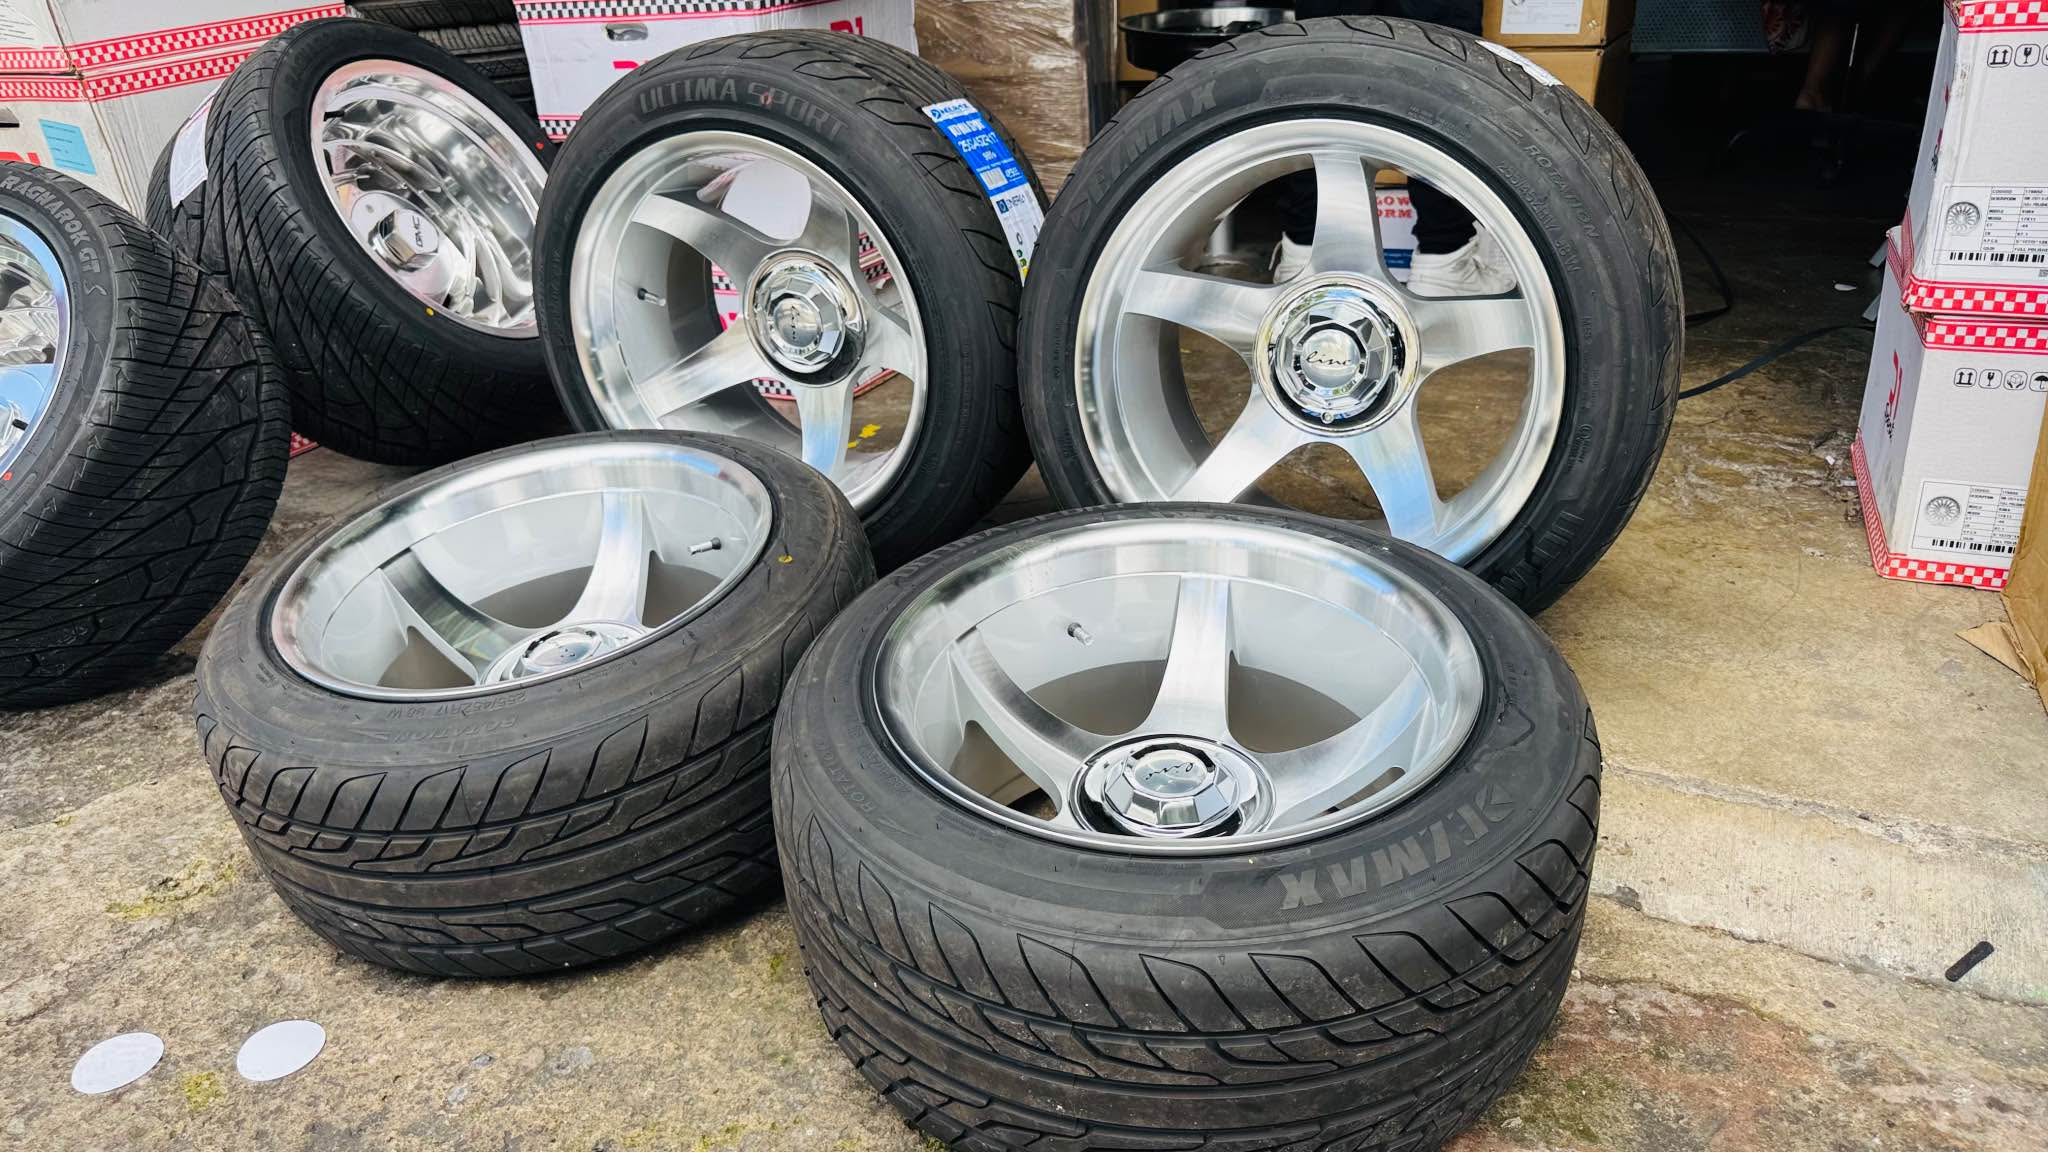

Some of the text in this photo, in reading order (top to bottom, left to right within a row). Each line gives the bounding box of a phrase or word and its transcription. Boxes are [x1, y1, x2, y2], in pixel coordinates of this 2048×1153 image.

[640, 78, 849, 140] ULTIMA SPORT
[0, 174, 91, 247] RAGNAROK
[411, 215, 425, 248] GMC
